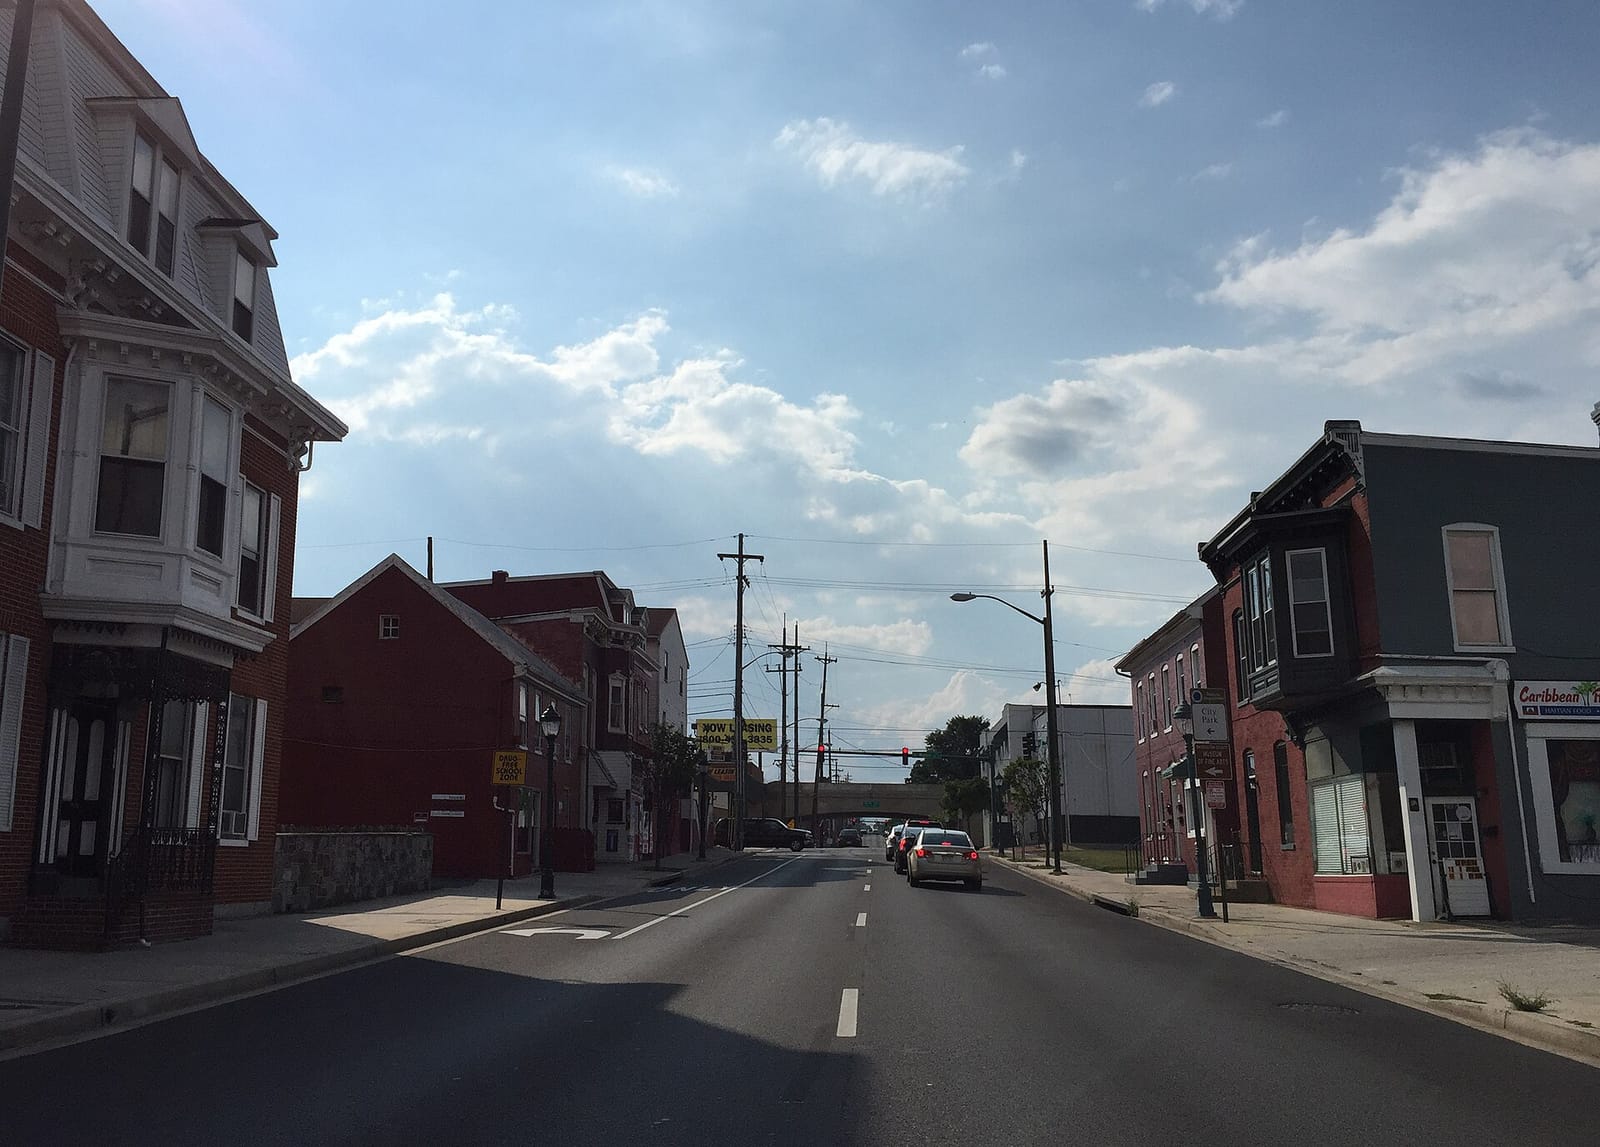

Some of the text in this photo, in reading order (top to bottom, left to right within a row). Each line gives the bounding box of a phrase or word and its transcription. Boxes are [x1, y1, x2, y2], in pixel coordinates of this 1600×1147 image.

[1519, 686, 1580, 703] Caribbean
[1201, 707, 1217, 716] City
[1202, 716, 1218, 724] Park
[702, 723, 726, 733] NOW
